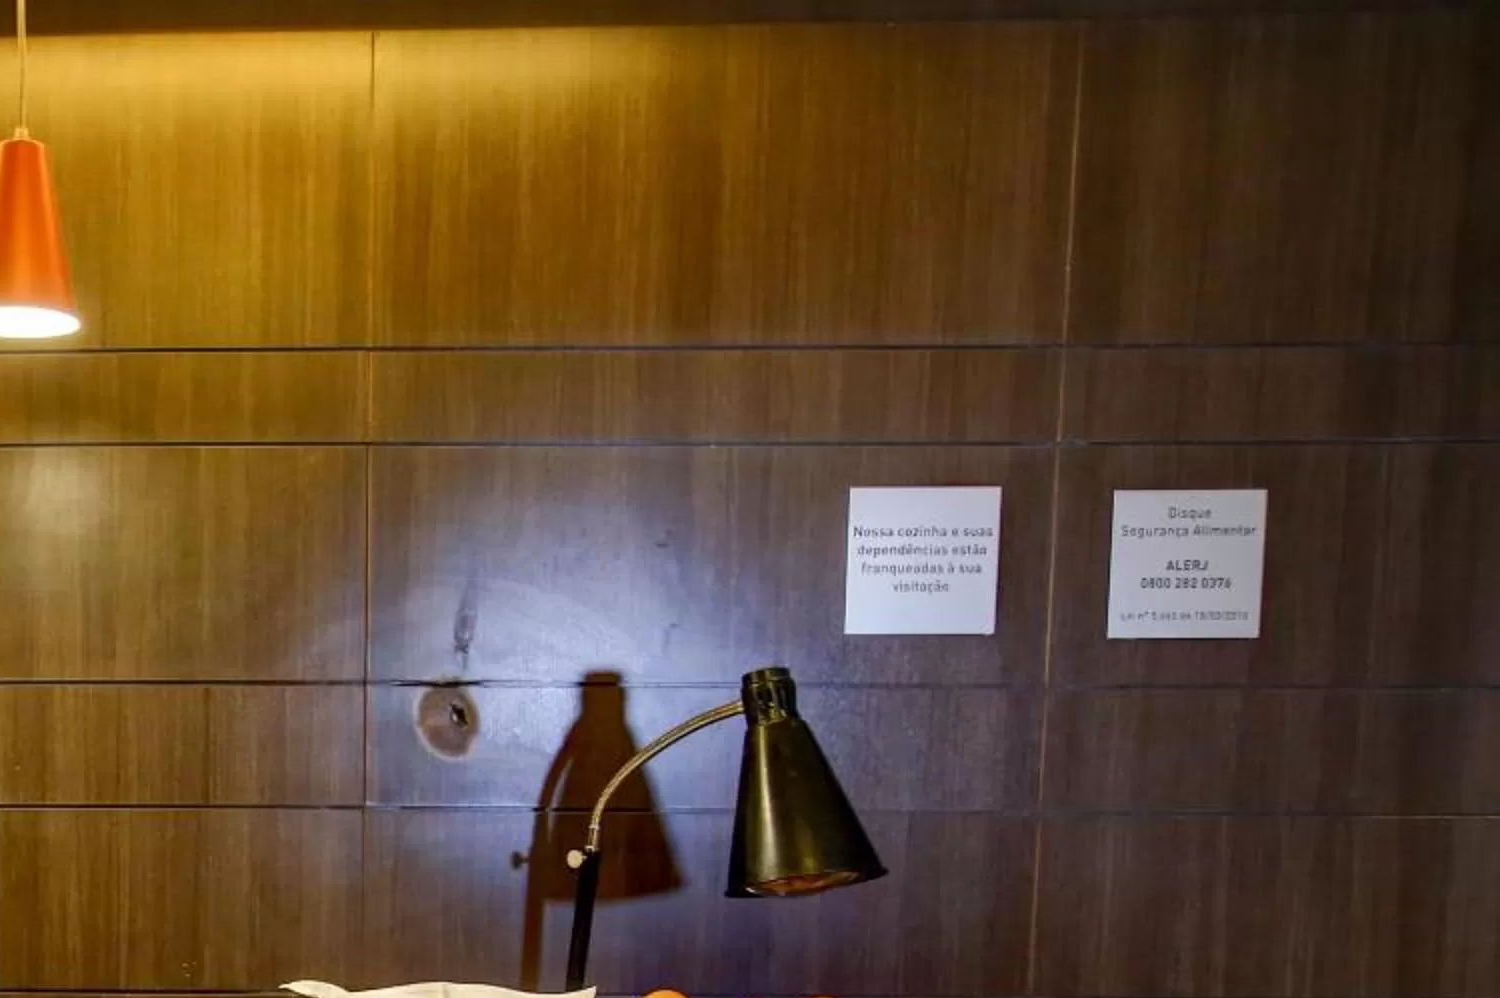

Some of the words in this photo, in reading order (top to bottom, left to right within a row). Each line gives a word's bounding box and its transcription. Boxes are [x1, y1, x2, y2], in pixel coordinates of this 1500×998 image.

[1167, 506, 1212, 522] Disque
[853, 526, 894, 537] Nossa
[897, 525, 948, 537] cozinha
[951, 528, 959, 537] e
[963, 527, 994, 537] suas
[1120, 525, 1189, 538] Segurança
[1192, 524, 1257, 537] Alimentar
[857, 543, 948, 558] dependências
[951, 543, 988, 556] estão
[861, 561, 944, 576] franqueadas
[947, 561, 955, 574] à
[959, 563, 983, 574] sua
[1165, 559, 1210, 571] ALERJ
[893, 580, 950, 595] visitação
[1140, 577, 1171, 589] 0800
